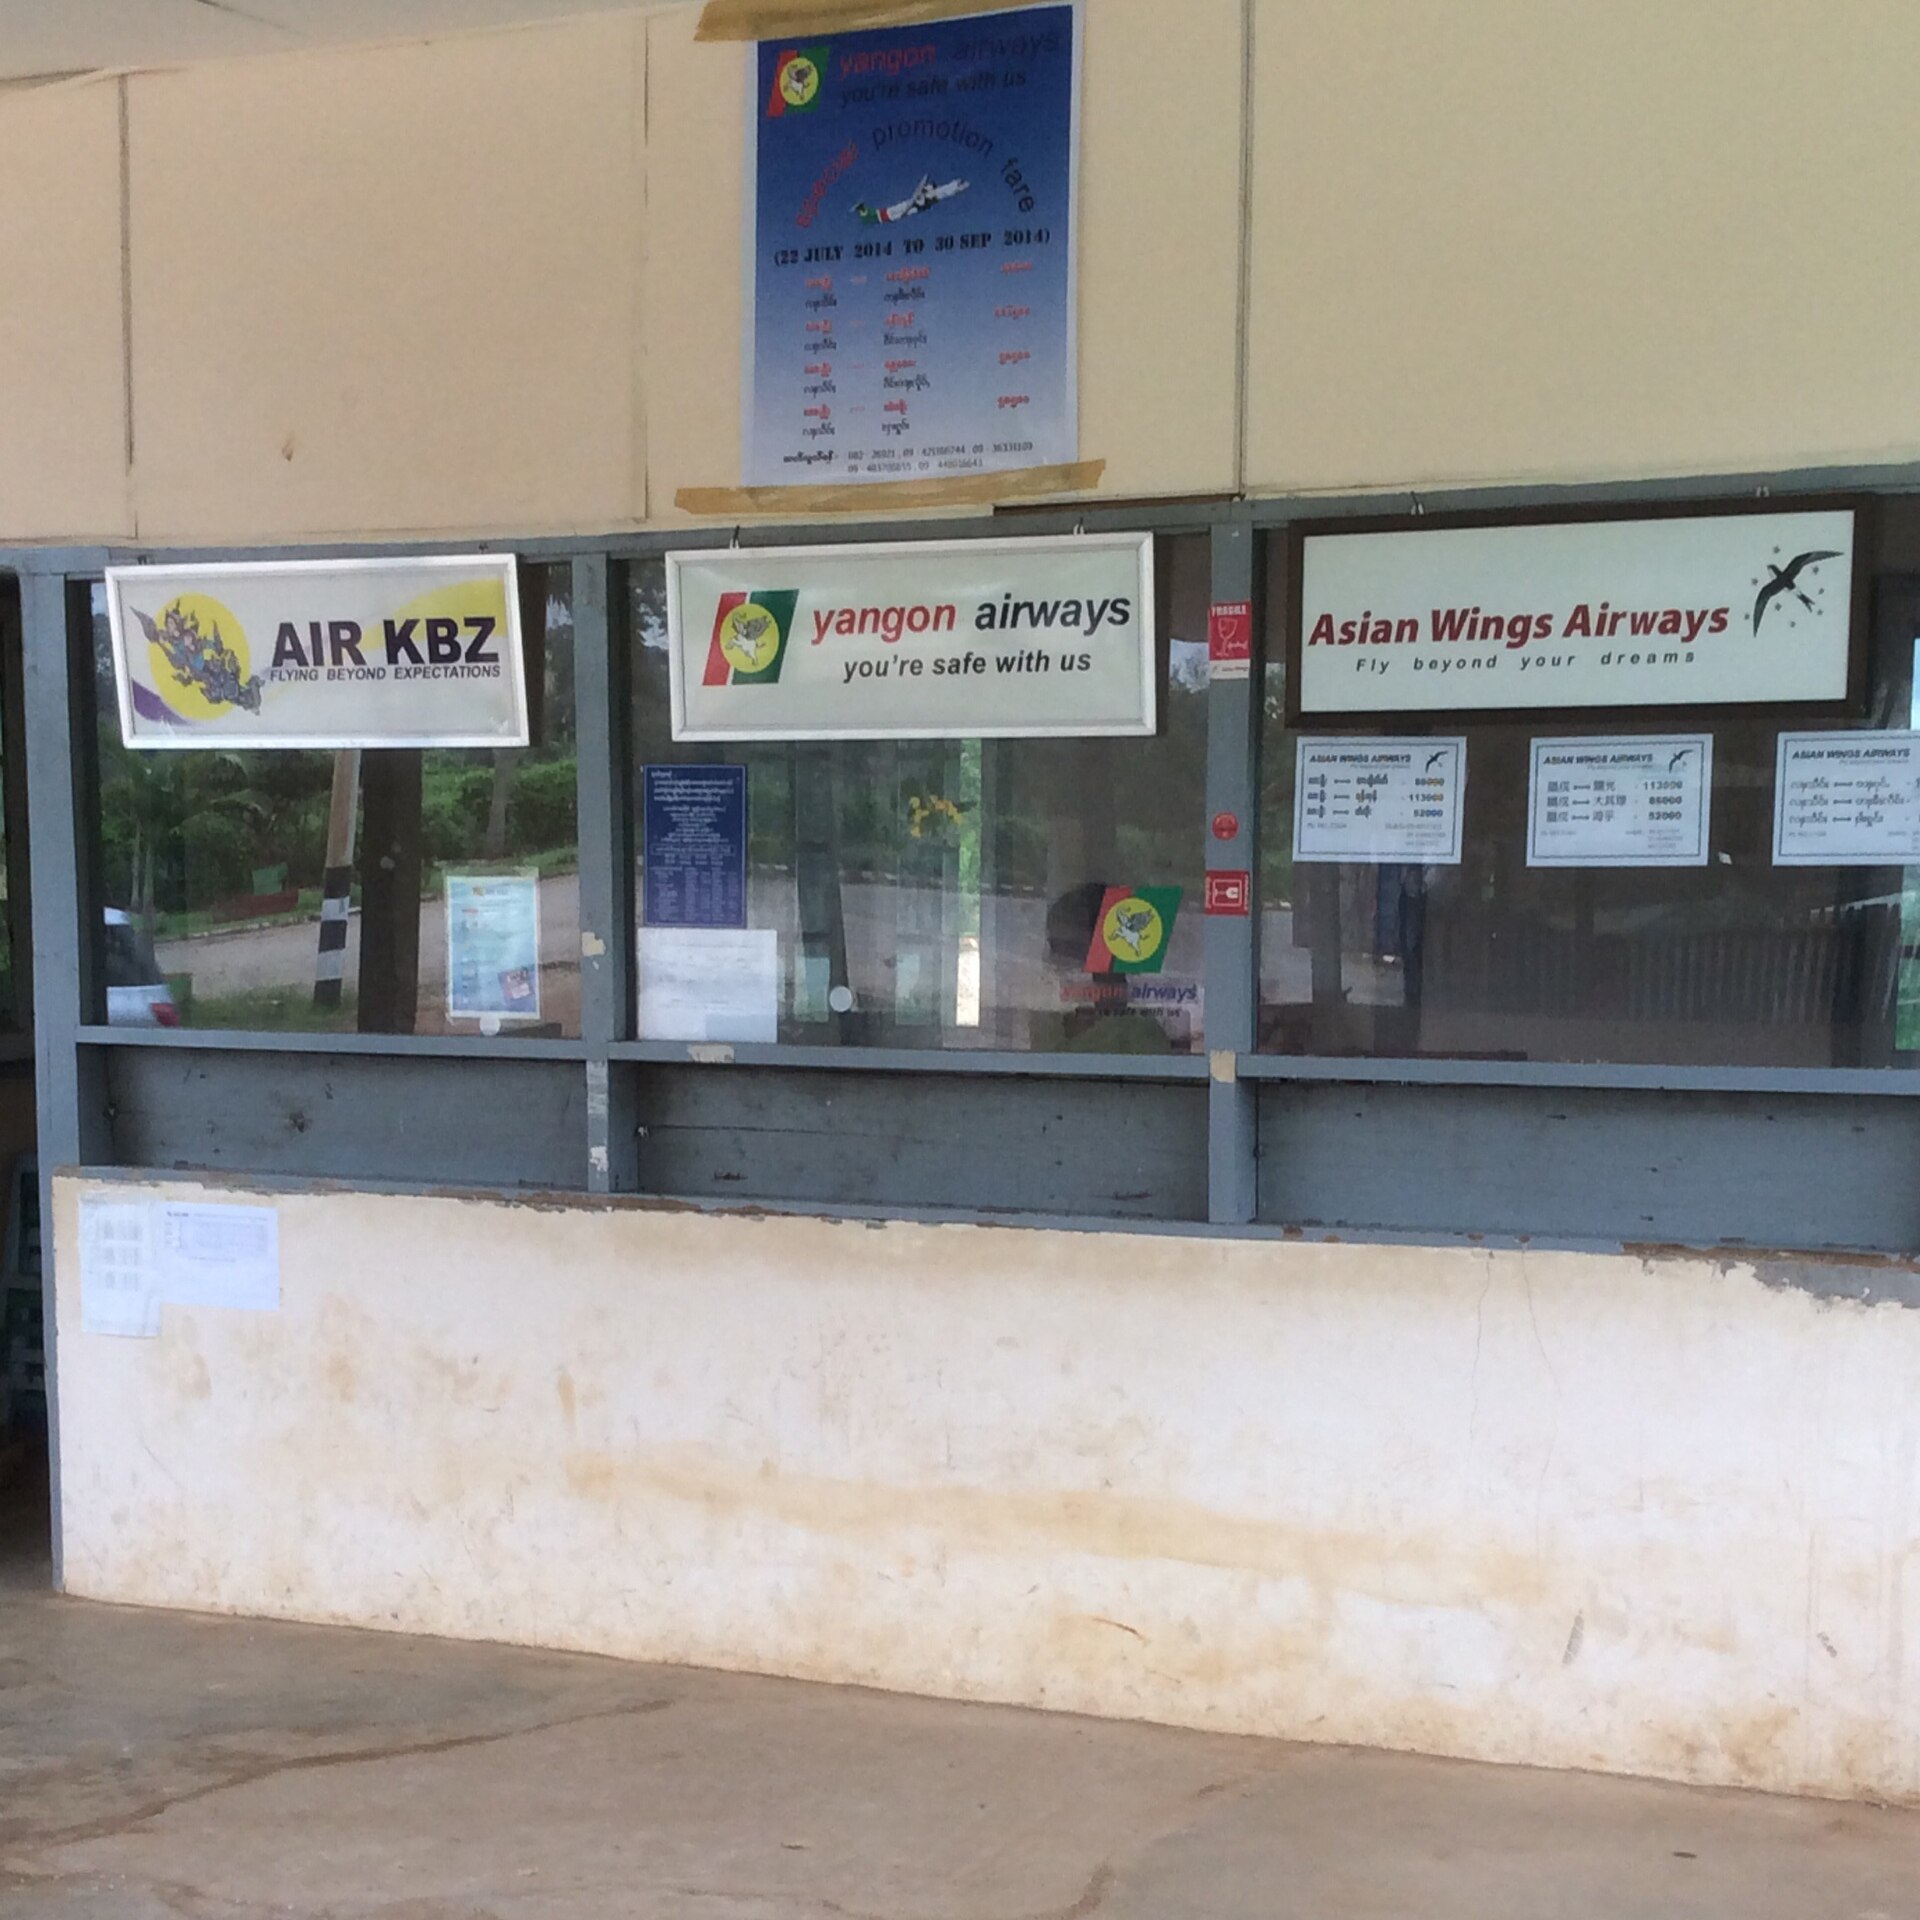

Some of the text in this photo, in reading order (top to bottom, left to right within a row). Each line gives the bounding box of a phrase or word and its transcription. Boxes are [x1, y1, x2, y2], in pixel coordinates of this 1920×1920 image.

[837, 44, 936, 81] yangon
[906, 76, 949, 95] safe
[956, 73, 996, 91] with
[1003, 71, 1027, 87] us
[872, 118, 994, 157] promotion
[1000, 157, 1035, 213] fare
[804, 246, 844, 262] JULY
[854, 242, 893, 258] 2014
[903, 239, 925, 254] TO
[935, 236, 955, 252] 30
[960, 232, 992, 249] SEP
[1003, 228, 1051, 246] 2014)
[810, 592, 1131, 645] yangon airways
[1308, 600, 1729, 649] Asian Wings Airways
[271, 616, 500, 668] AIR KBZ
[270, 664, 501, 681] FLYING BEYOND EXPECTATIONS
[843, 648, 1092, 684] you're safe with us
[1356, 650, 1696, 675] Fly beyond your dreams
[1131, 983, 1199, 1004] airways
